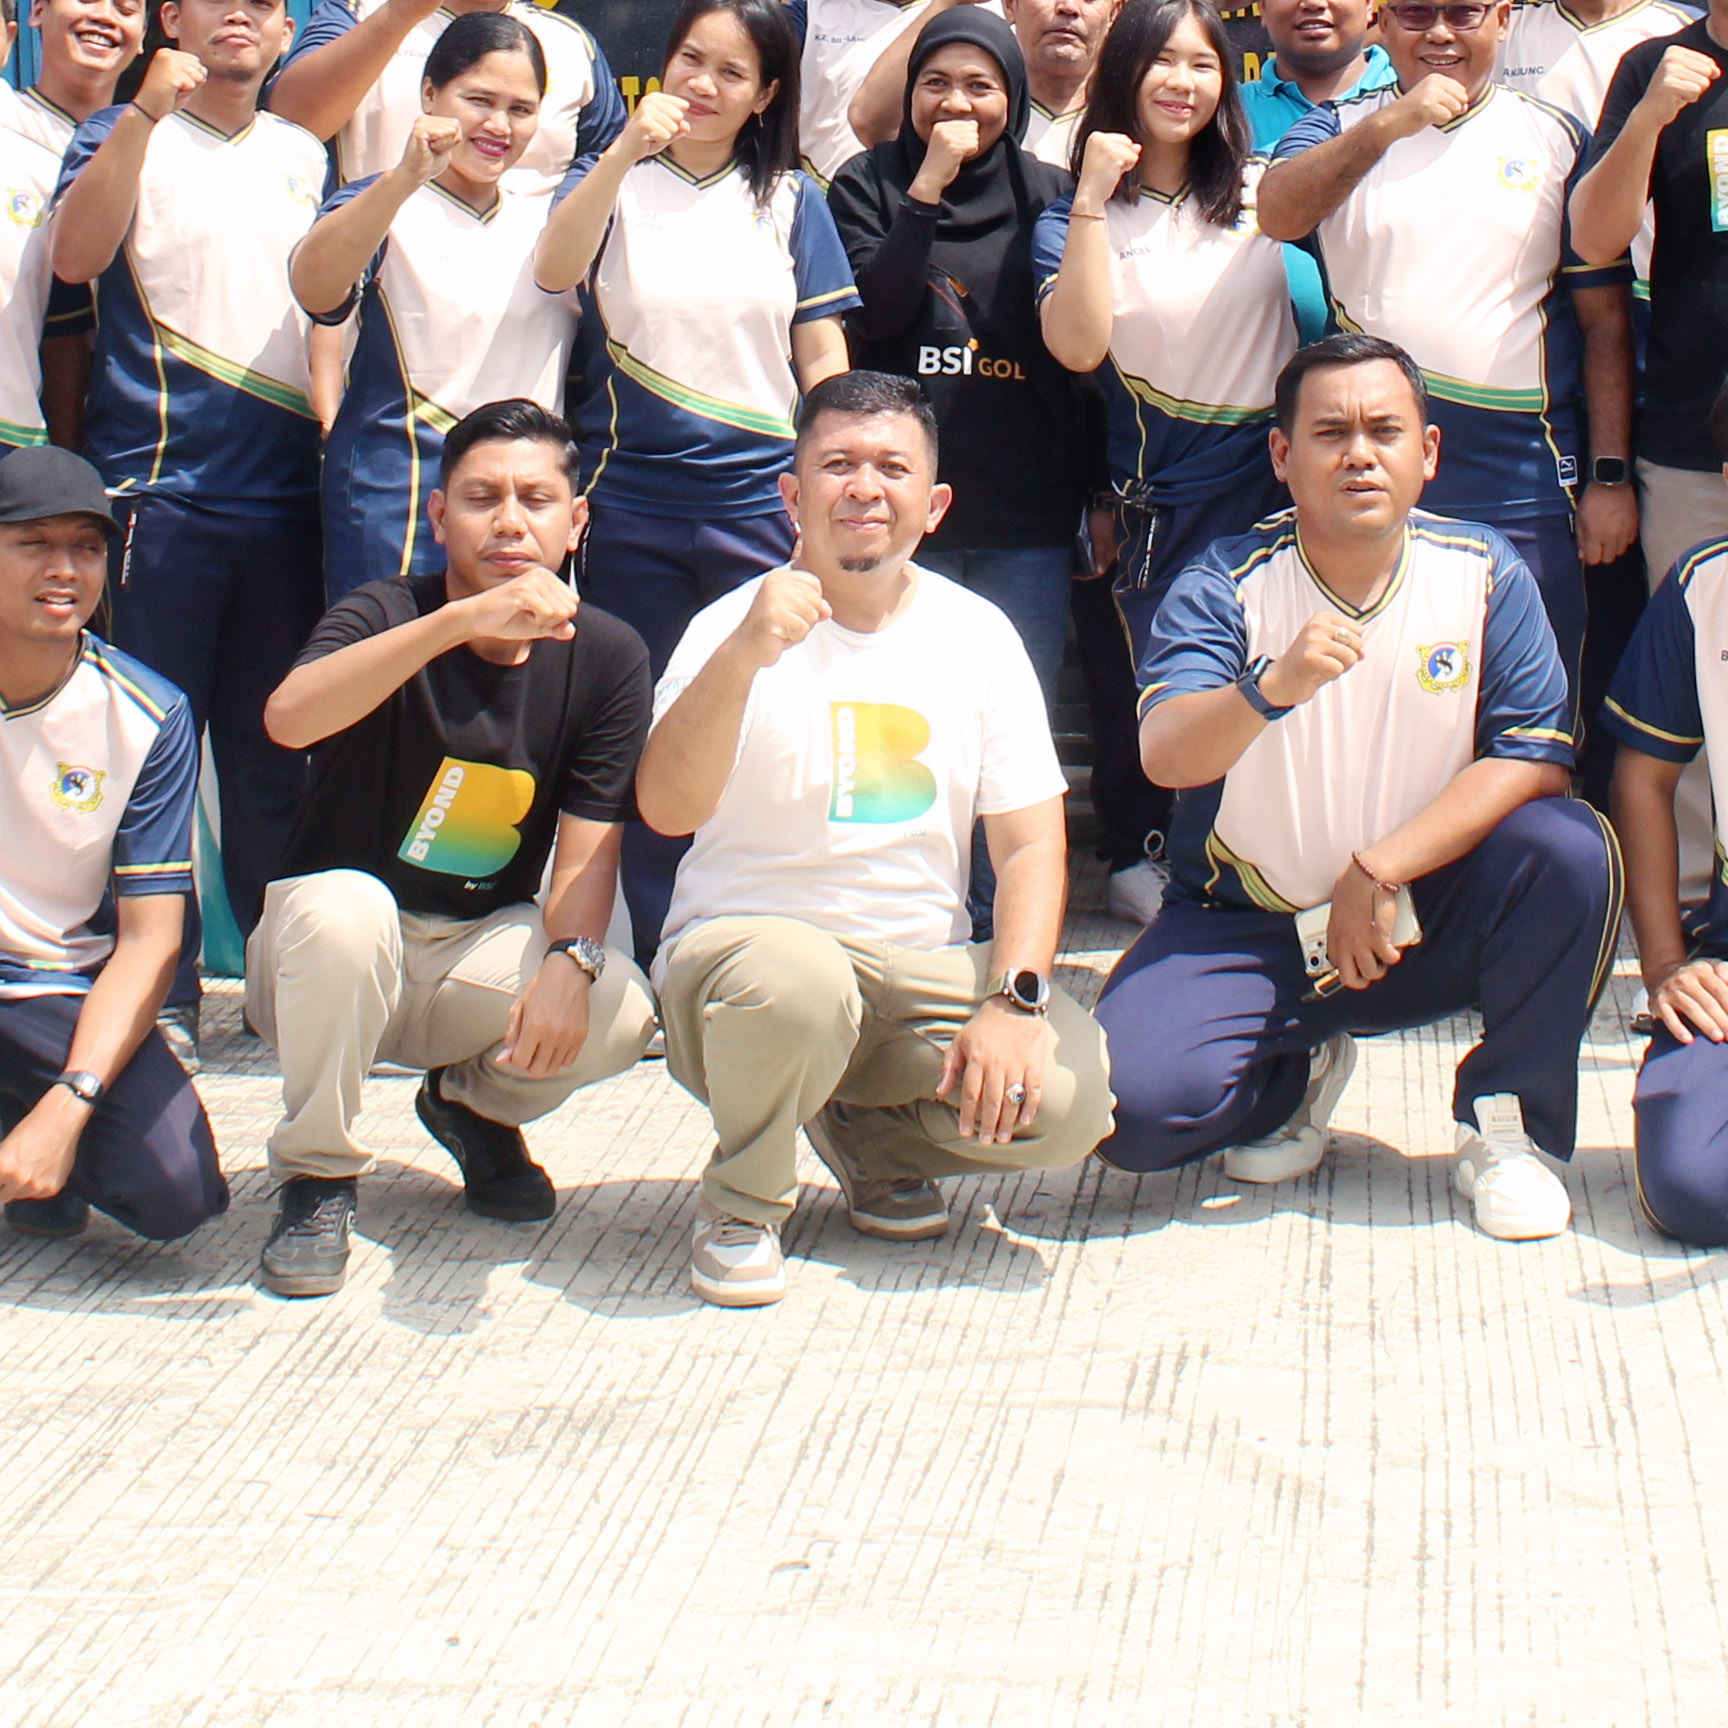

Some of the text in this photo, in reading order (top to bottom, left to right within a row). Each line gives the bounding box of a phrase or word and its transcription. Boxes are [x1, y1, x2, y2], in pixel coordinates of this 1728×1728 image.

[918, 345, 1026, 380] BSI GOL
[836, 706, 857, 818] BYOND
[406, 766, 465, 862] BYOND
